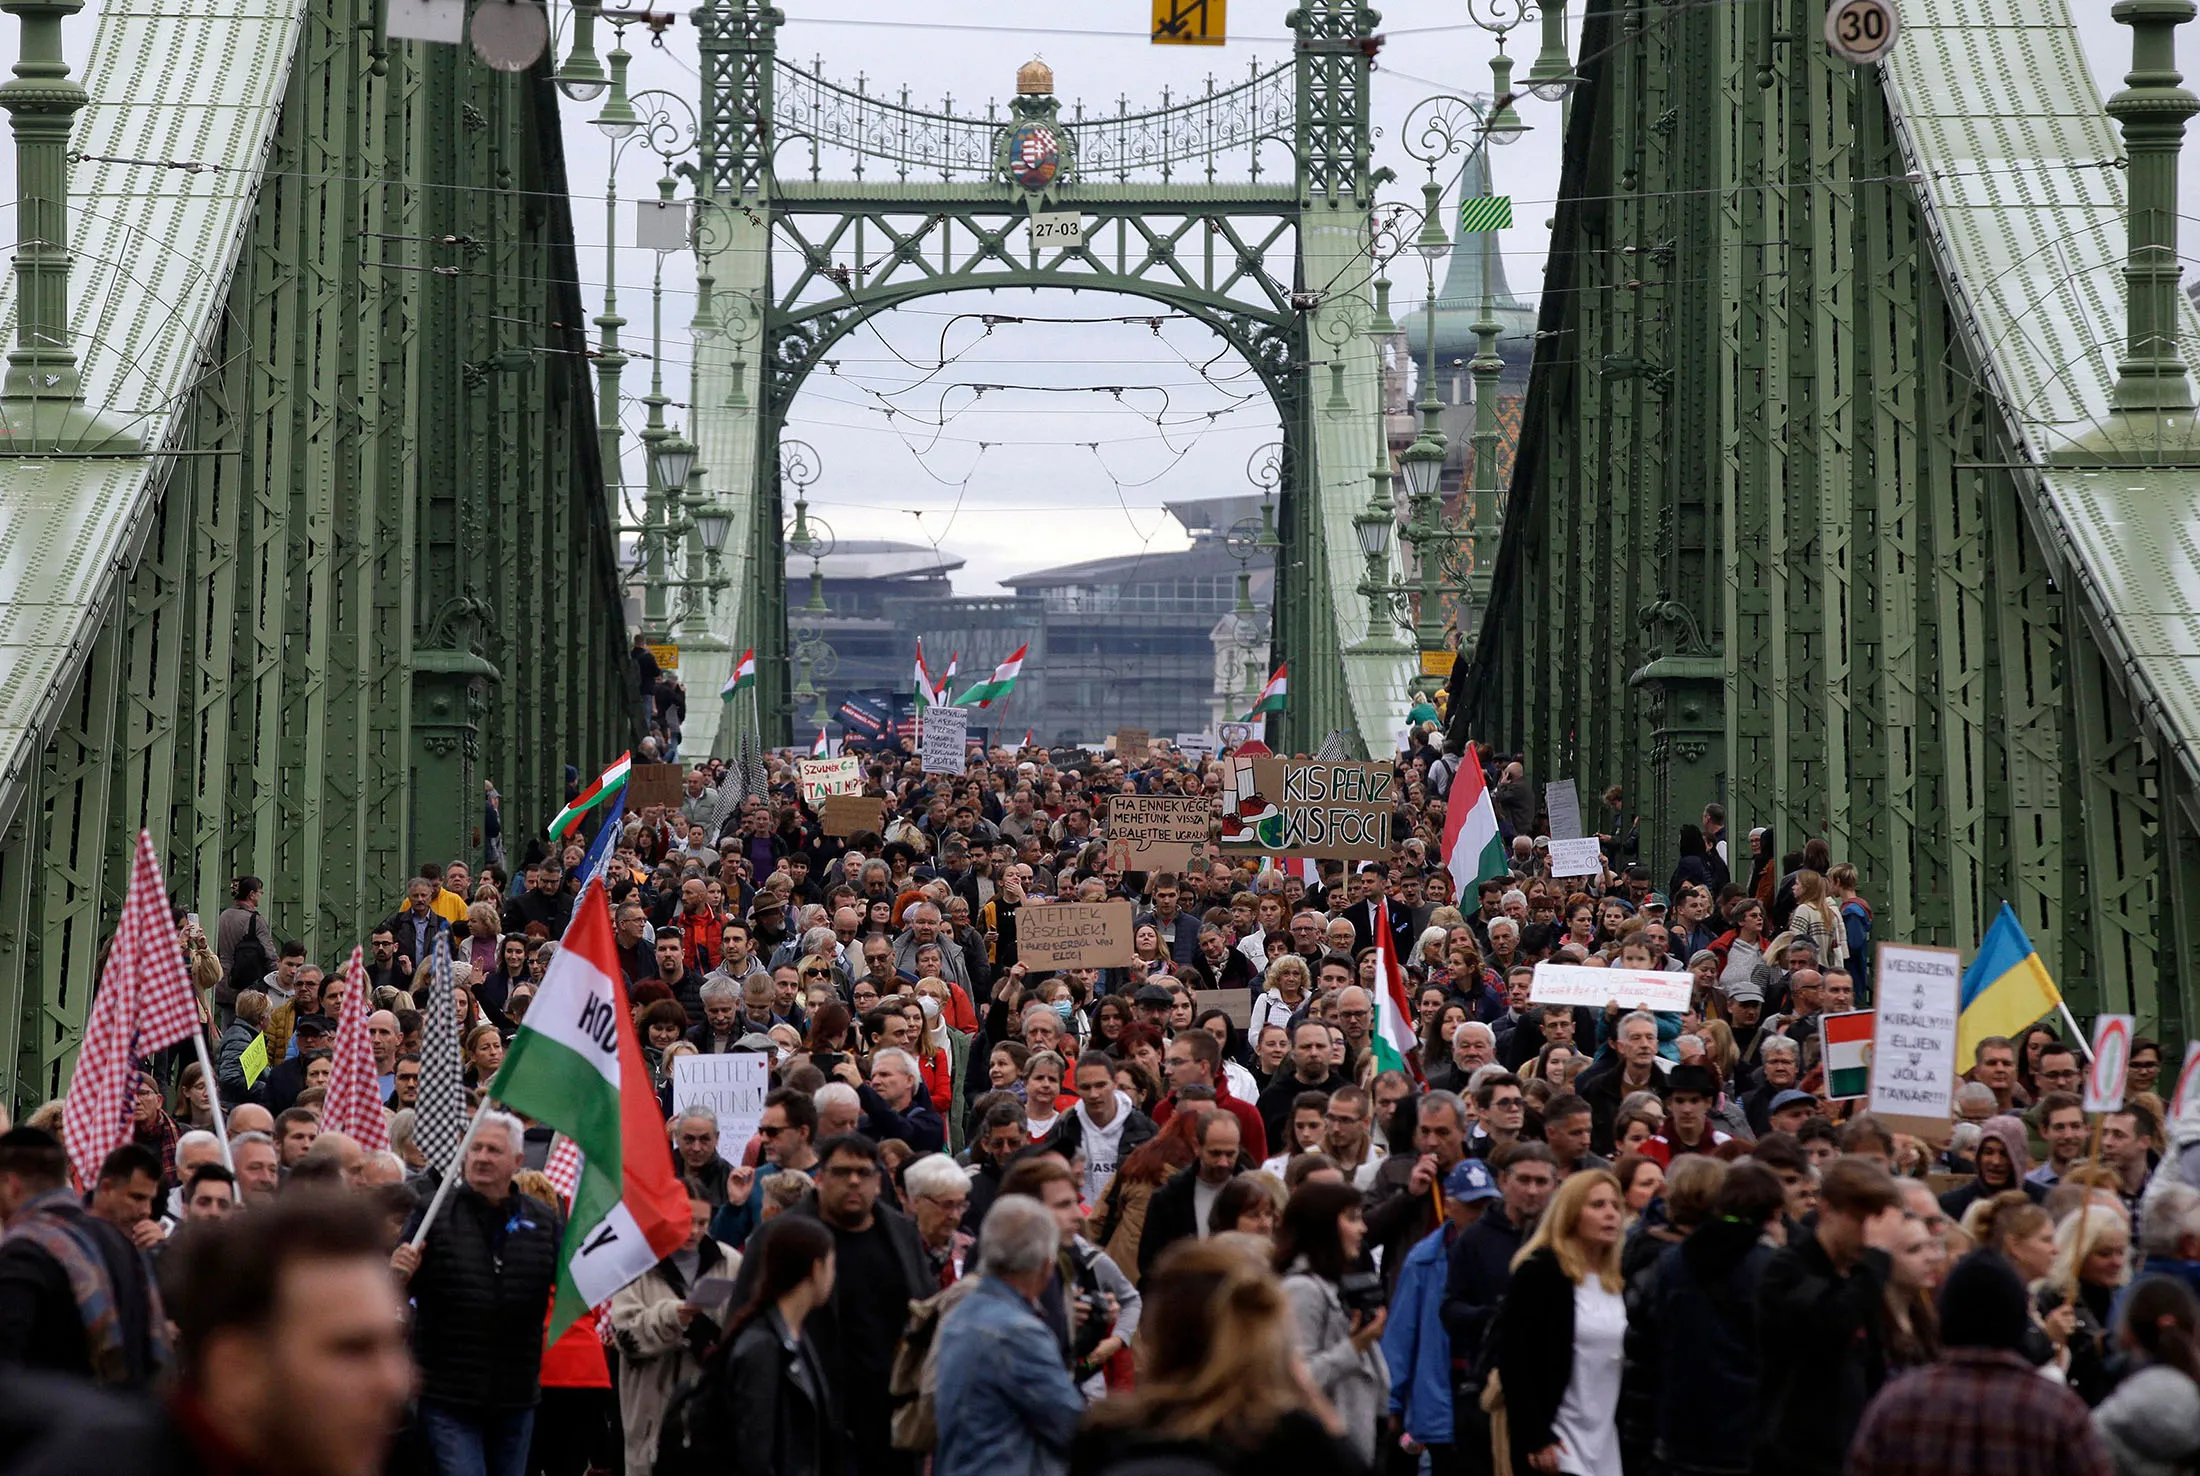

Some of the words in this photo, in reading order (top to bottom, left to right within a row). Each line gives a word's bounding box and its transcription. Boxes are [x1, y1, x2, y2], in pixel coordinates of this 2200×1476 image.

[1843, 8, 1882, 41] 30
[1036, 222, 1079, 238] 27-03
[1283, 764, 1327, 802] KIS
[1115, 799, 1136, 811] HA
[1139, 800, 1179, 812] ENNEK
[1176, 814, 1204, 825] VISSZA
[1282, 806, 1326, 846] KIS
[1328, 808, 1388, 849] FÖCI
